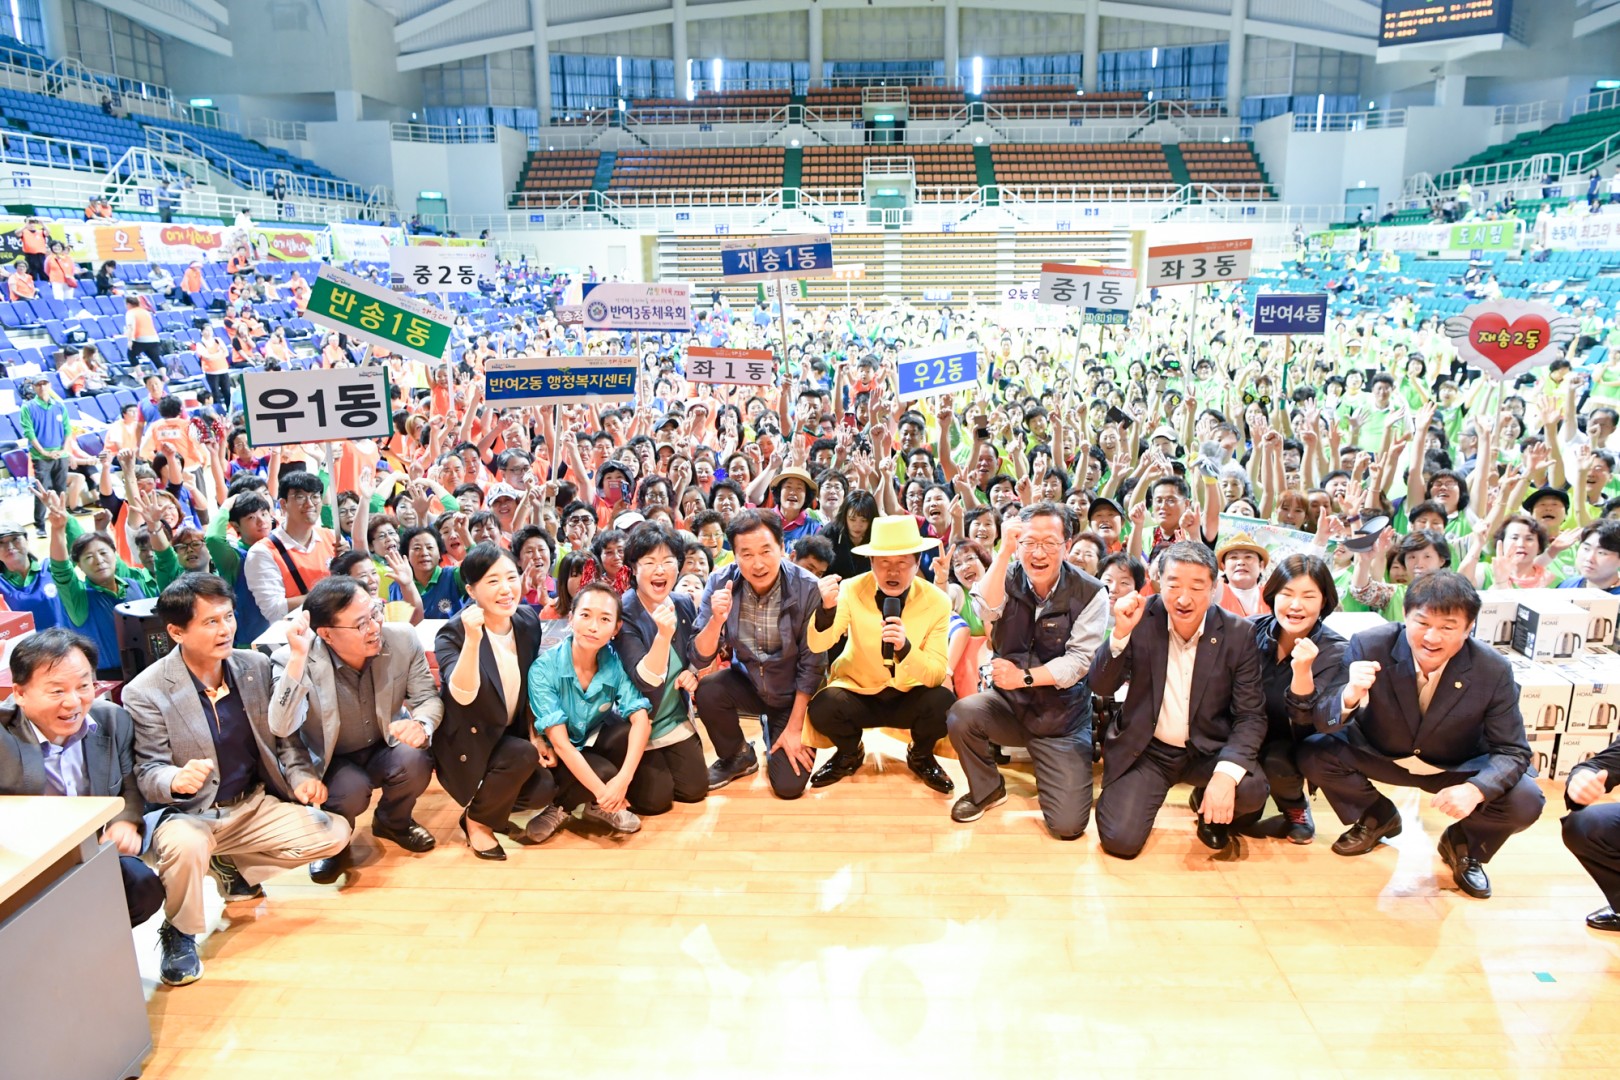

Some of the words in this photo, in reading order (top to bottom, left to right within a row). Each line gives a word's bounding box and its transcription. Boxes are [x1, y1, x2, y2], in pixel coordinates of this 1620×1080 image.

[738, 247, 817, 273] 재송1동
[328, 288, 432, 347] 반송1동
[610, 305, 686, 320] 반여3동체육회
[1260, 304, 1322, 324] 반여4동
[1478, 328, 1540, 350] 재송2동
[489, 375, 543, 393] 반여2동
[547, 373, 632, 390] 행정복지센터
[913, 357, 963, 388] 우2동
[256, 383, 381, 433] 우1동
